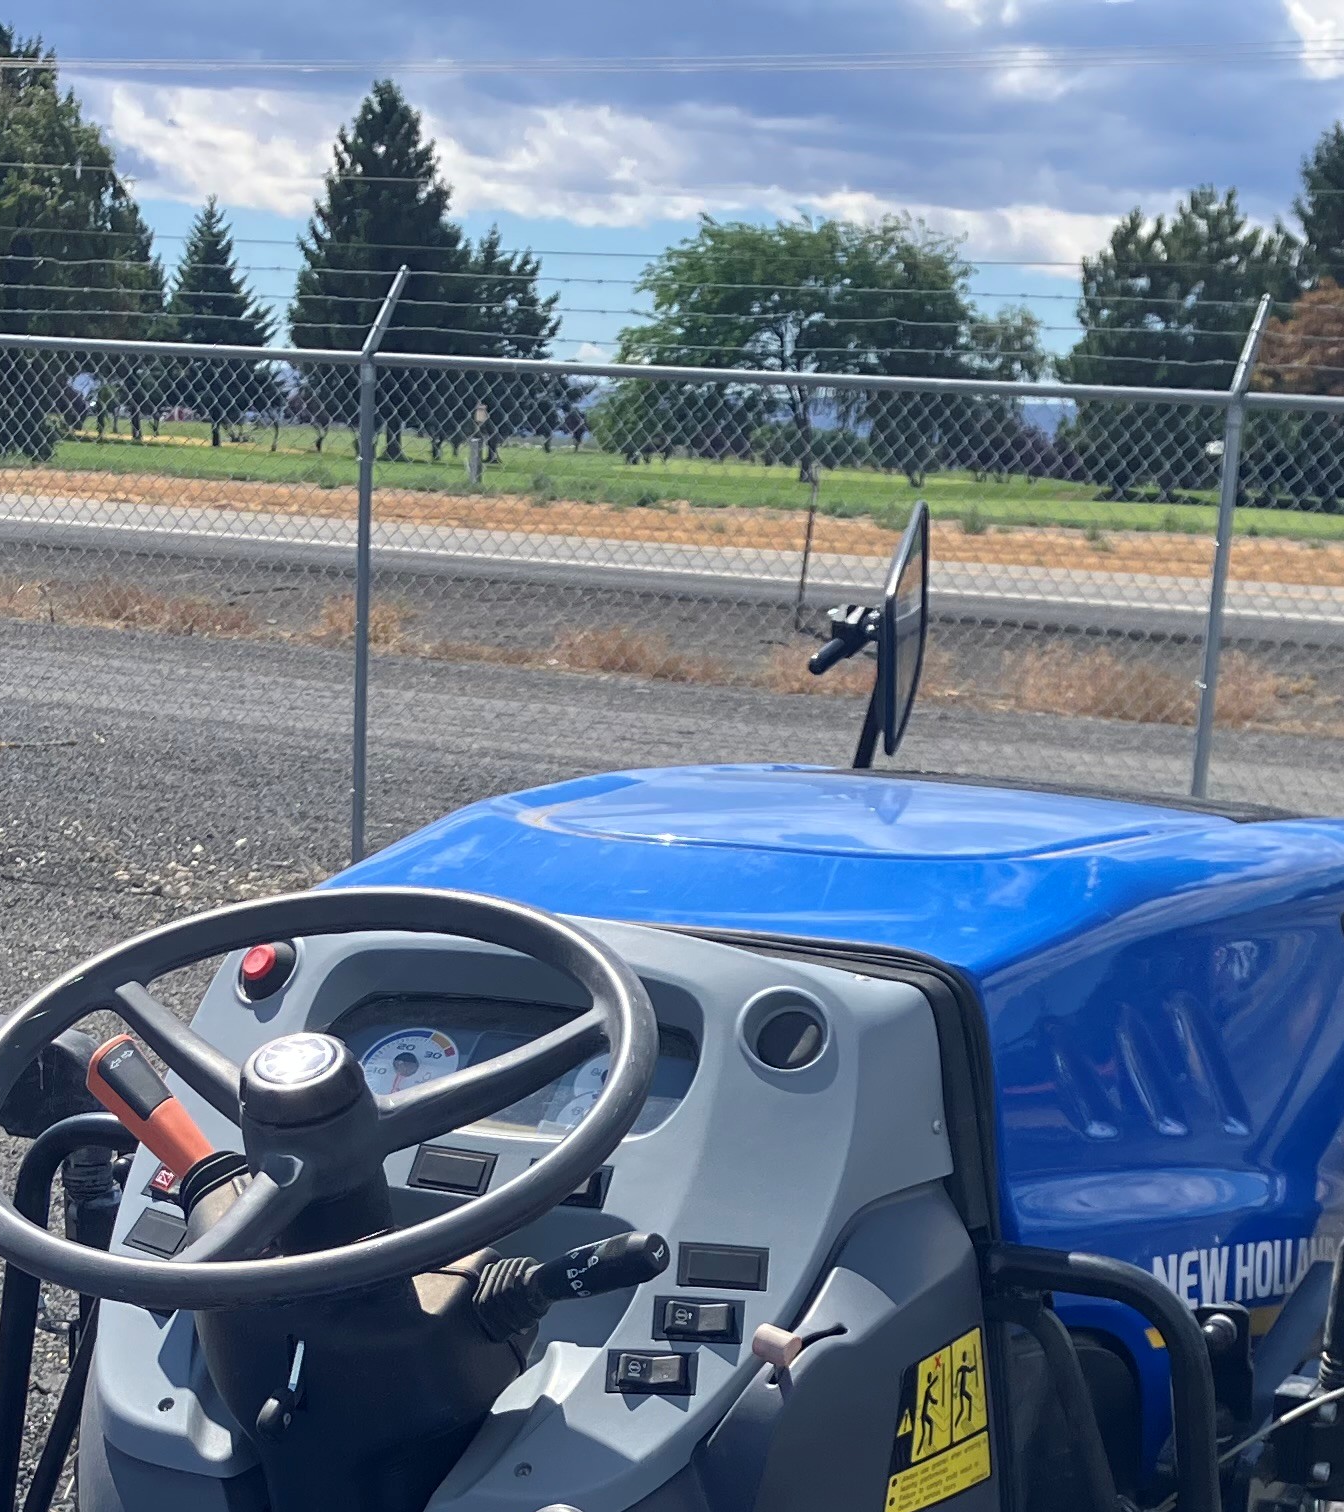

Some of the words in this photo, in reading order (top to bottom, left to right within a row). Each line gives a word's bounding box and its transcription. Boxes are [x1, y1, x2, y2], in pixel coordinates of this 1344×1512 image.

[396, 1043, 417, 1052] 20
[423, 1050, 443, 1060] 30
[373, 1066, 388, 1075] 10
[1152, 1245, 1230, 1311] NEW
